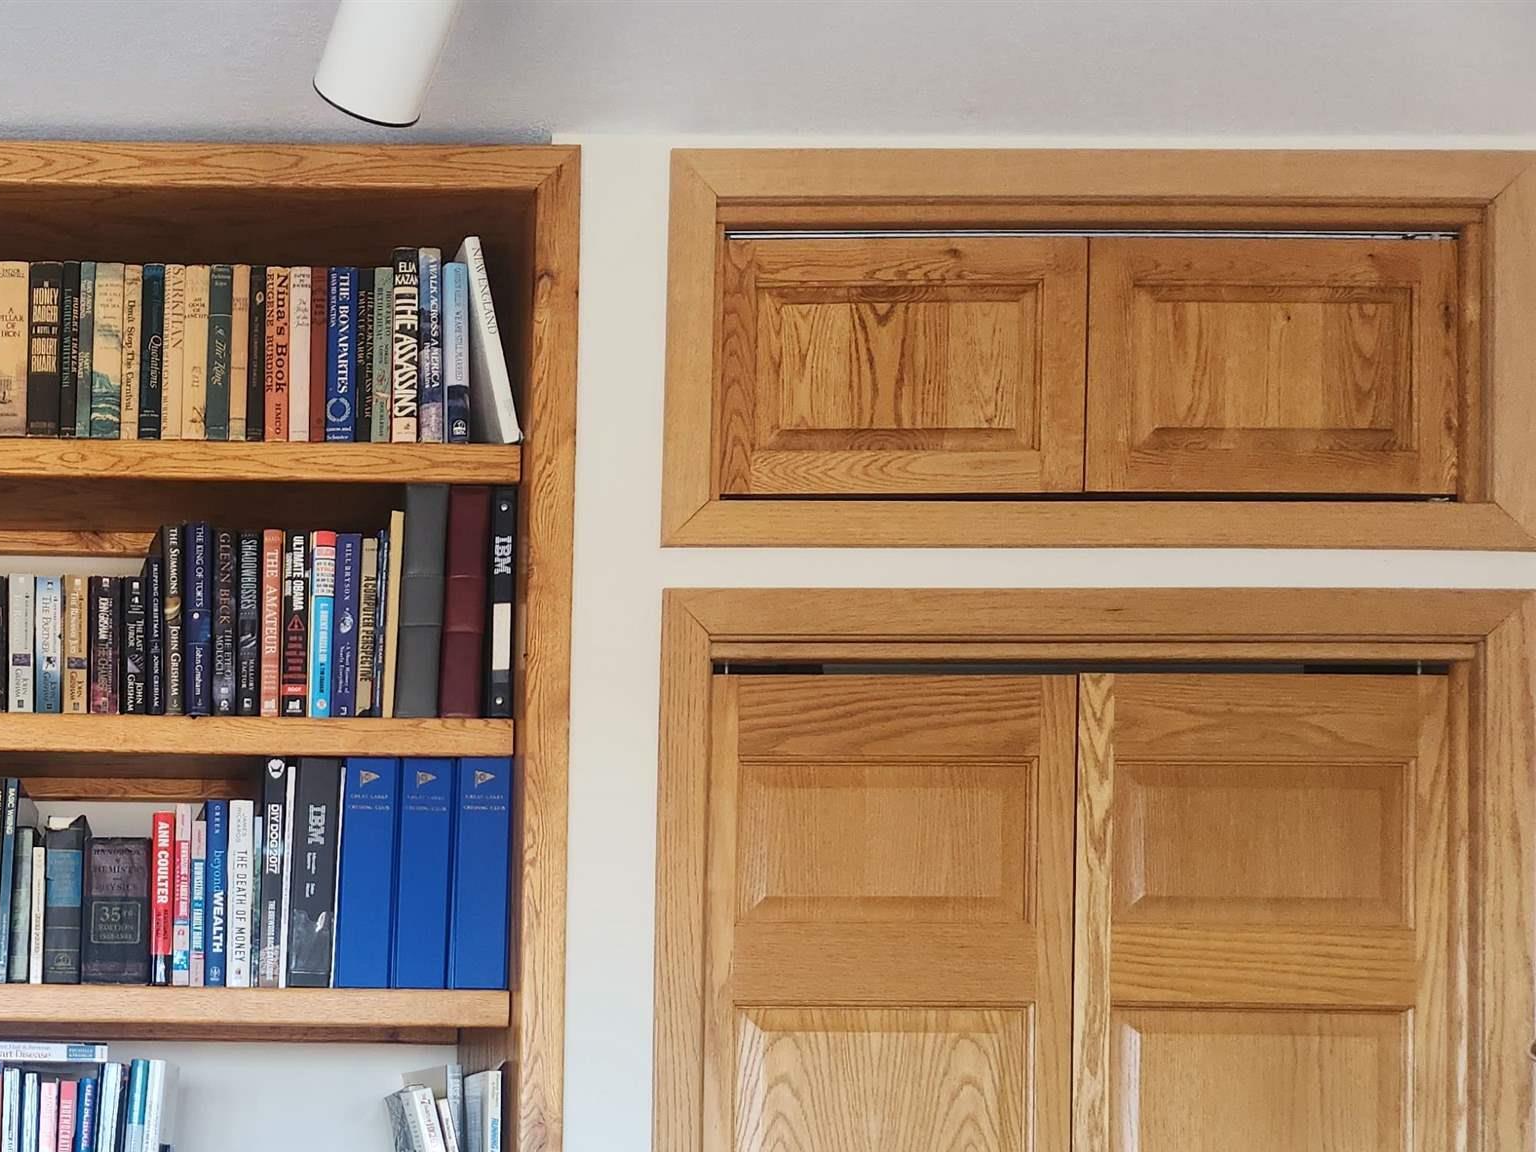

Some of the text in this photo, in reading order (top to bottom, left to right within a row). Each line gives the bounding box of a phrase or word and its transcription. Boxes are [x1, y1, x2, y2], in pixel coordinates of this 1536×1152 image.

[395, 274, 418, 285] KAZAN
[399, 262, 416, 273] ELIA
[429, 264, 437, 293] WALK
[171, 267, 183, 349] SARKHAN
[277, 273, 287, 335] Nina's
[430, 295, 438, 336] ACROSS
[478, 277, 497, 334] ENGLAND
[32, 338, 57, 355] ROBERT
[125, 326, 135, 348] Stop
[337, 273, 350, 393] THE BONAPARTES
[62, 336, 70, 387] WHITEFISH
[125, 350, 134, 369] The
[148, 335, 161, 389] Quotations
[275, 343, 287, 392] Book
[394, 294, 417, 417] THE ASSASSINS
[431, 338, 439, 387] AMERICA
[125, 371, 134, 411] Carnival
[196, 567, 203, 578] OF
[220, 533, 230, 582] GLENN
[241, 539, 257, 609] SHADOWBOSSES
[293, 536, 304, 610] ULTIMATE OBAMA
[494, 536, 512, 574] IBM
[169, 528, 181, 696] THE SUMMONS JOHN GRISHAM
[220, 589, 232, 624] BECK
[265, 550, 278, 655] THE AMATEUR
[362, 583, 376, 627] COMPUTER
[42, 596, 52, 653] THE PARTNER
[135, 619, 144, 651] THE LAST
[224, 628, 232, 649] THE
[195, 646, 203, 665] John
[216, 635, 224, 675] MOLOCH
[224, 651, 232, 666] EYE
[360, 630, 375, 682] PERSPECTIVE
[127, 674, 135, 711] GRISHAM
[135, 682, 144, 704] JOHN
[269, 804, 278, 874] DIY DOG 2017
[307, 804, 326, 845] IBM
[158, 822, 169, 904] ANN COULTER
[209, 850, 224, 892] beyond
[213, 892, 223, 953] WEALTH
[235, 851, 248, 962] THE DEATH OF MONEY
[491, 1118, 499, 1148] RUNNING
